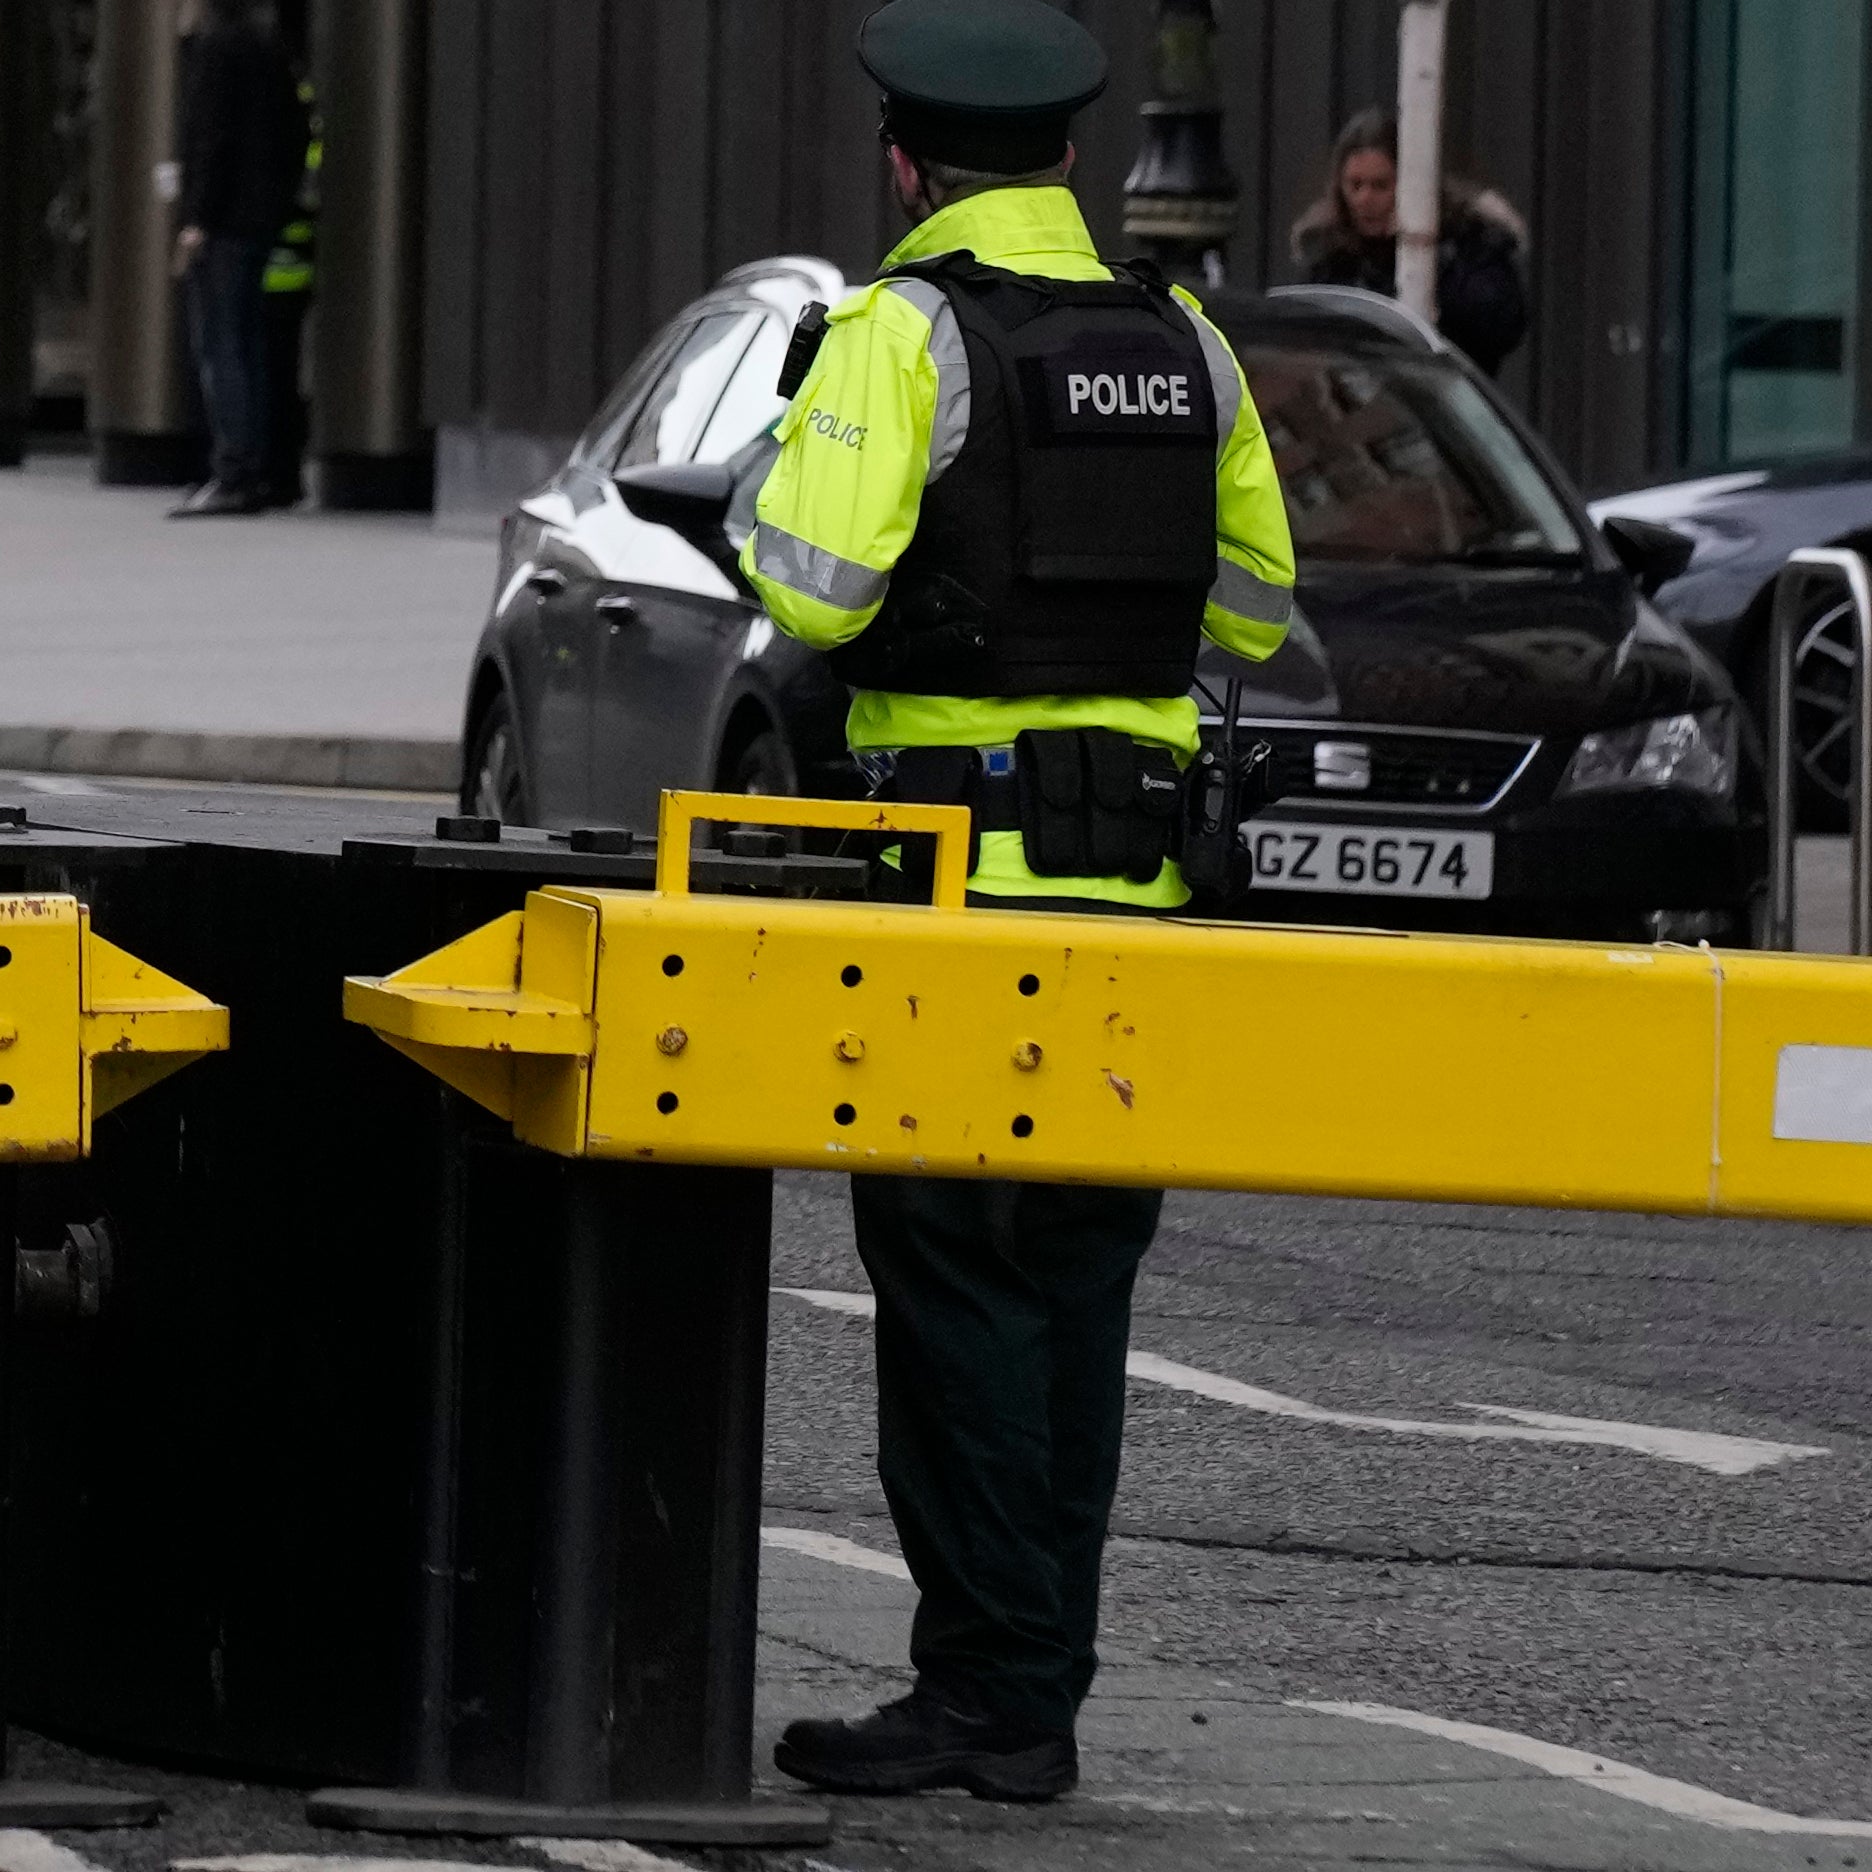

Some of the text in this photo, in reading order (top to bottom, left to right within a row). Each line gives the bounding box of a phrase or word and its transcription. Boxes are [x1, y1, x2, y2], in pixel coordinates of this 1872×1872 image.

[1067, 373, 1191, 416] POLICE
[805, 408, 868, 451] POLICE
[1237, 831, 1468, 888] GZ 6674
